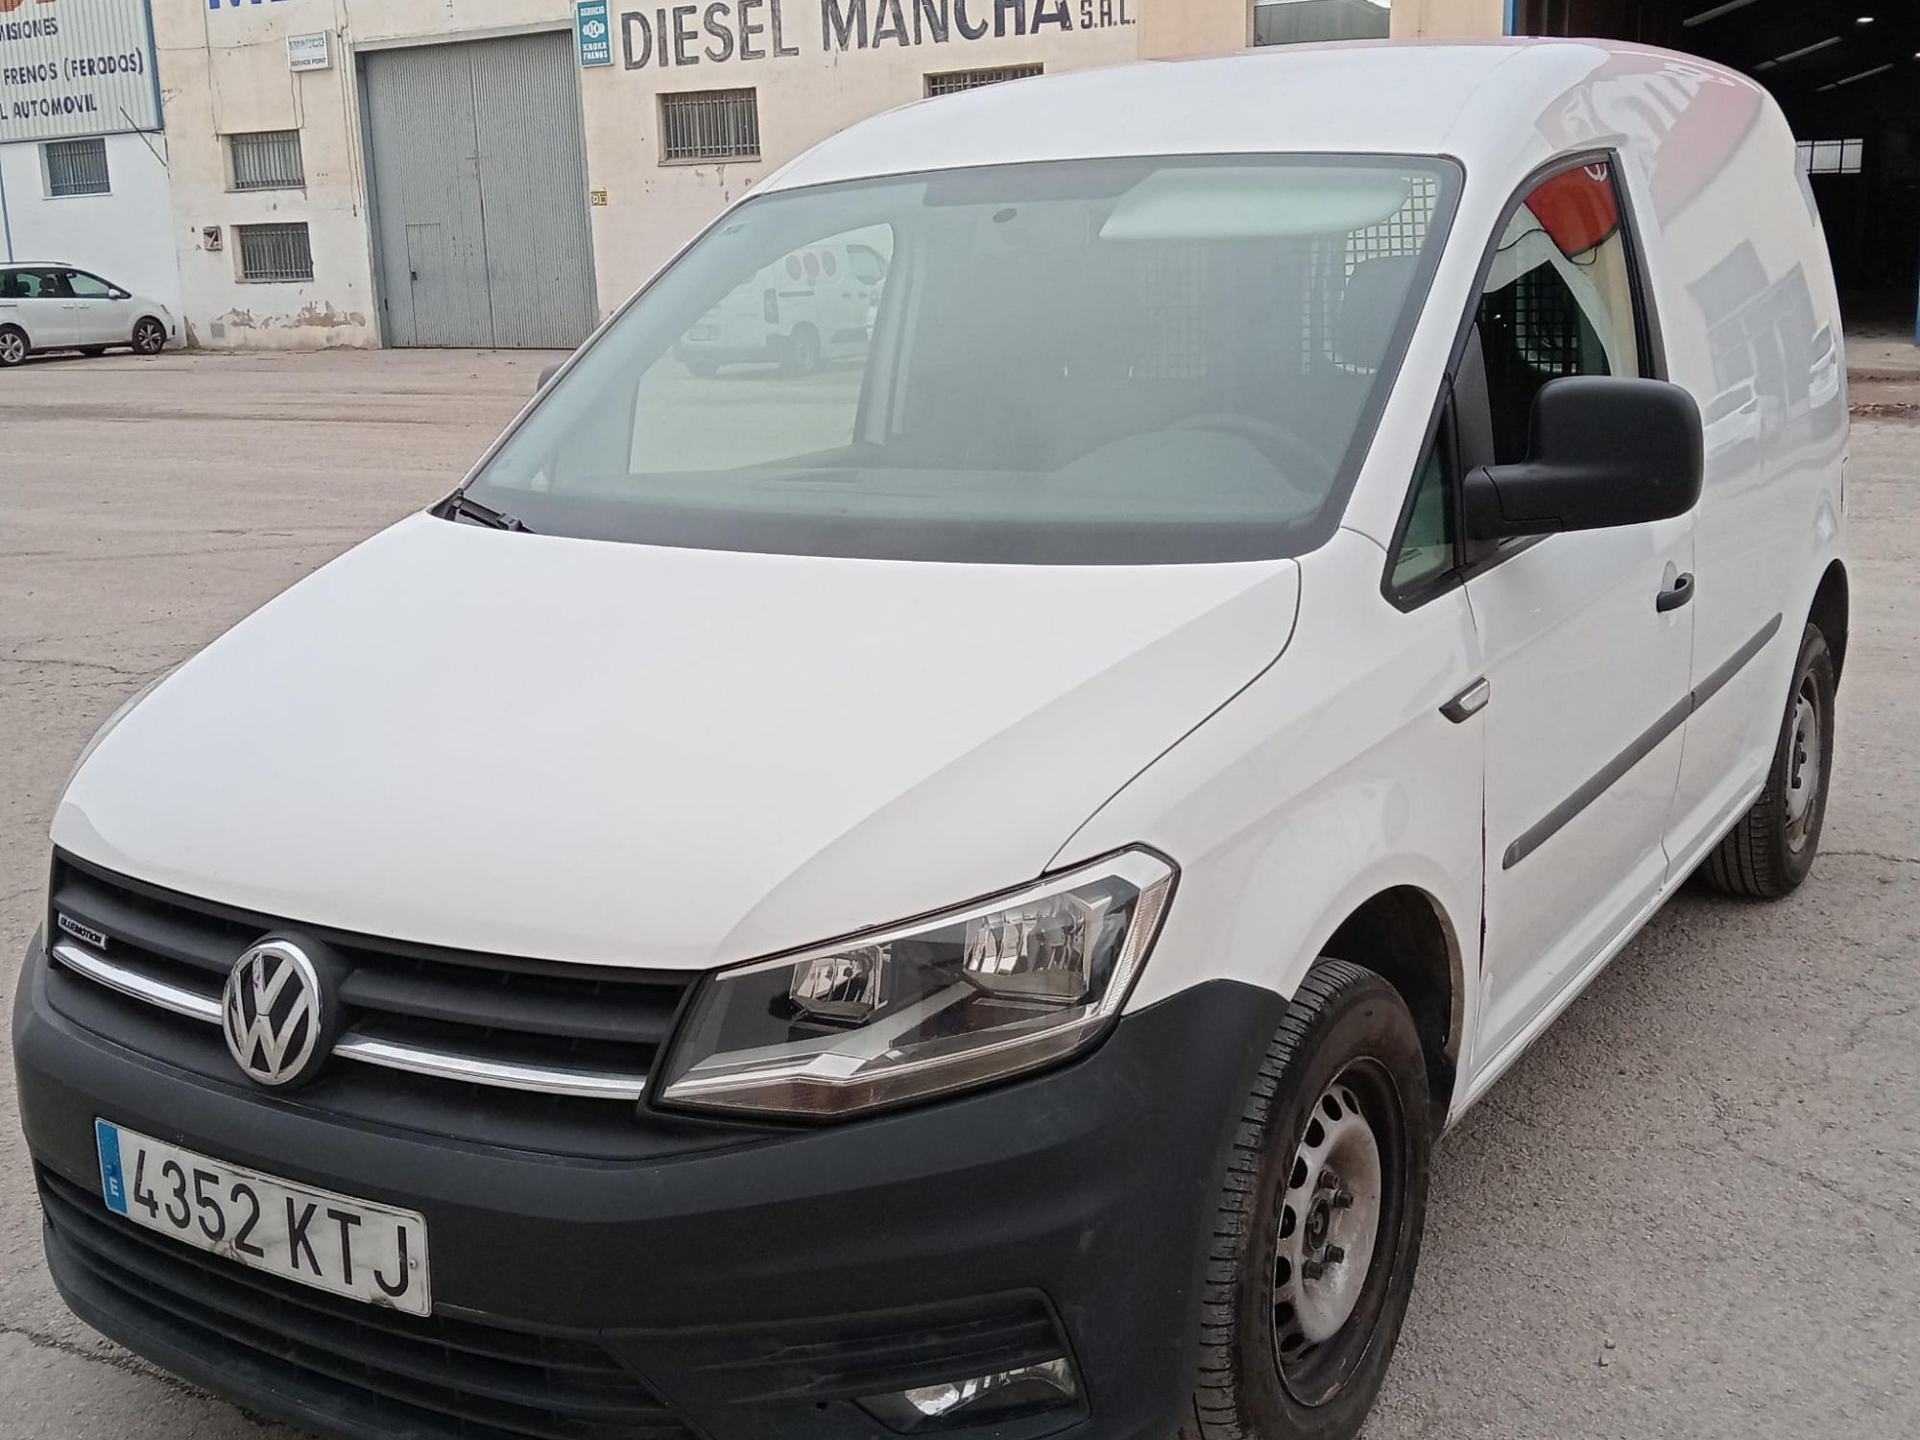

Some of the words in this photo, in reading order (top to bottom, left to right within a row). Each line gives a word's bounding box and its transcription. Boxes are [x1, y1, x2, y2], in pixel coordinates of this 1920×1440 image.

[621, 0, 800, 70] DIESEL
[821, 0, 1074, 51] MANCHA
[3, 62, 58, 86] FRENOS
[63, 46, 144, 82] (FERODOS)
[13, 93, 97, 119] AUTOMOVIL
[133, 1149, 264, 1258] 4352
[286, 1196, 409, 1297] KTJ
